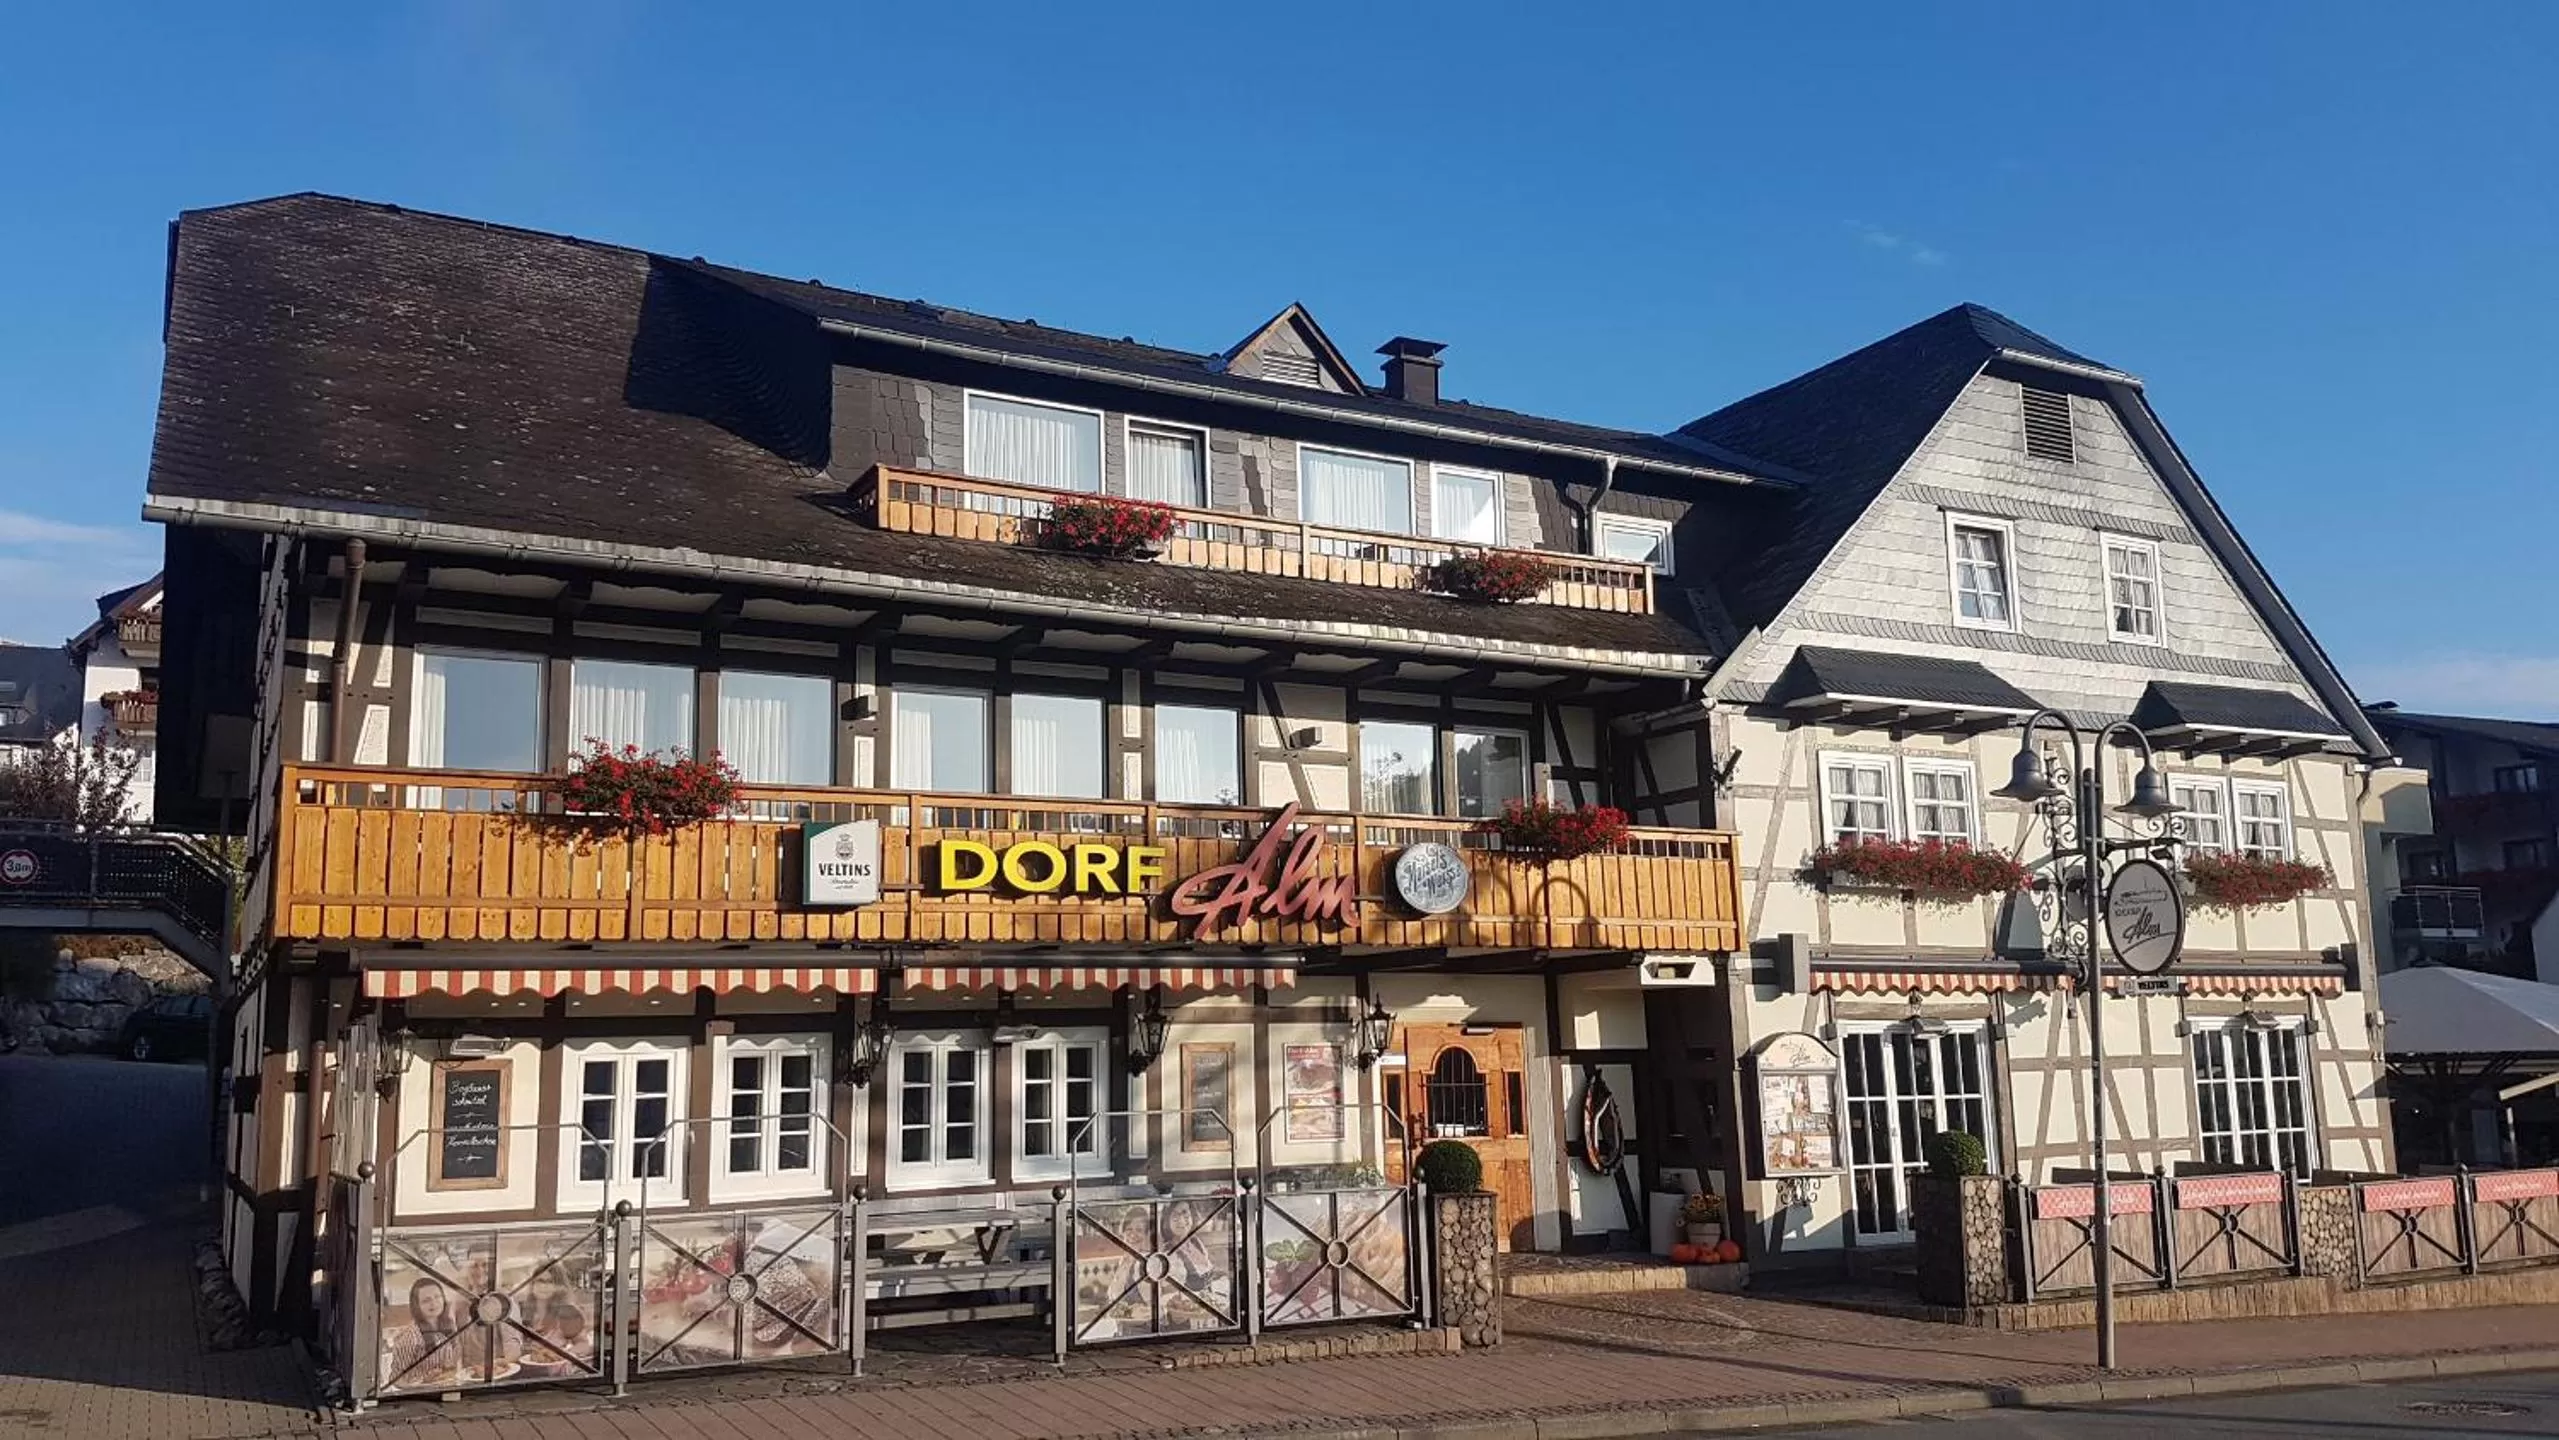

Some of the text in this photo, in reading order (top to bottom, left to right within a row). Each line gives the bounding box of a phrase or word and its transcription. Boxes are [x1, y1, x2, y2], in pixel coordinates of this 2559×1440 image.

[818, 862, 871, 876] VELTINS
[941, 800, 1360, 940] DORF Alm
[2122, 905, 2161, 944] Alm
